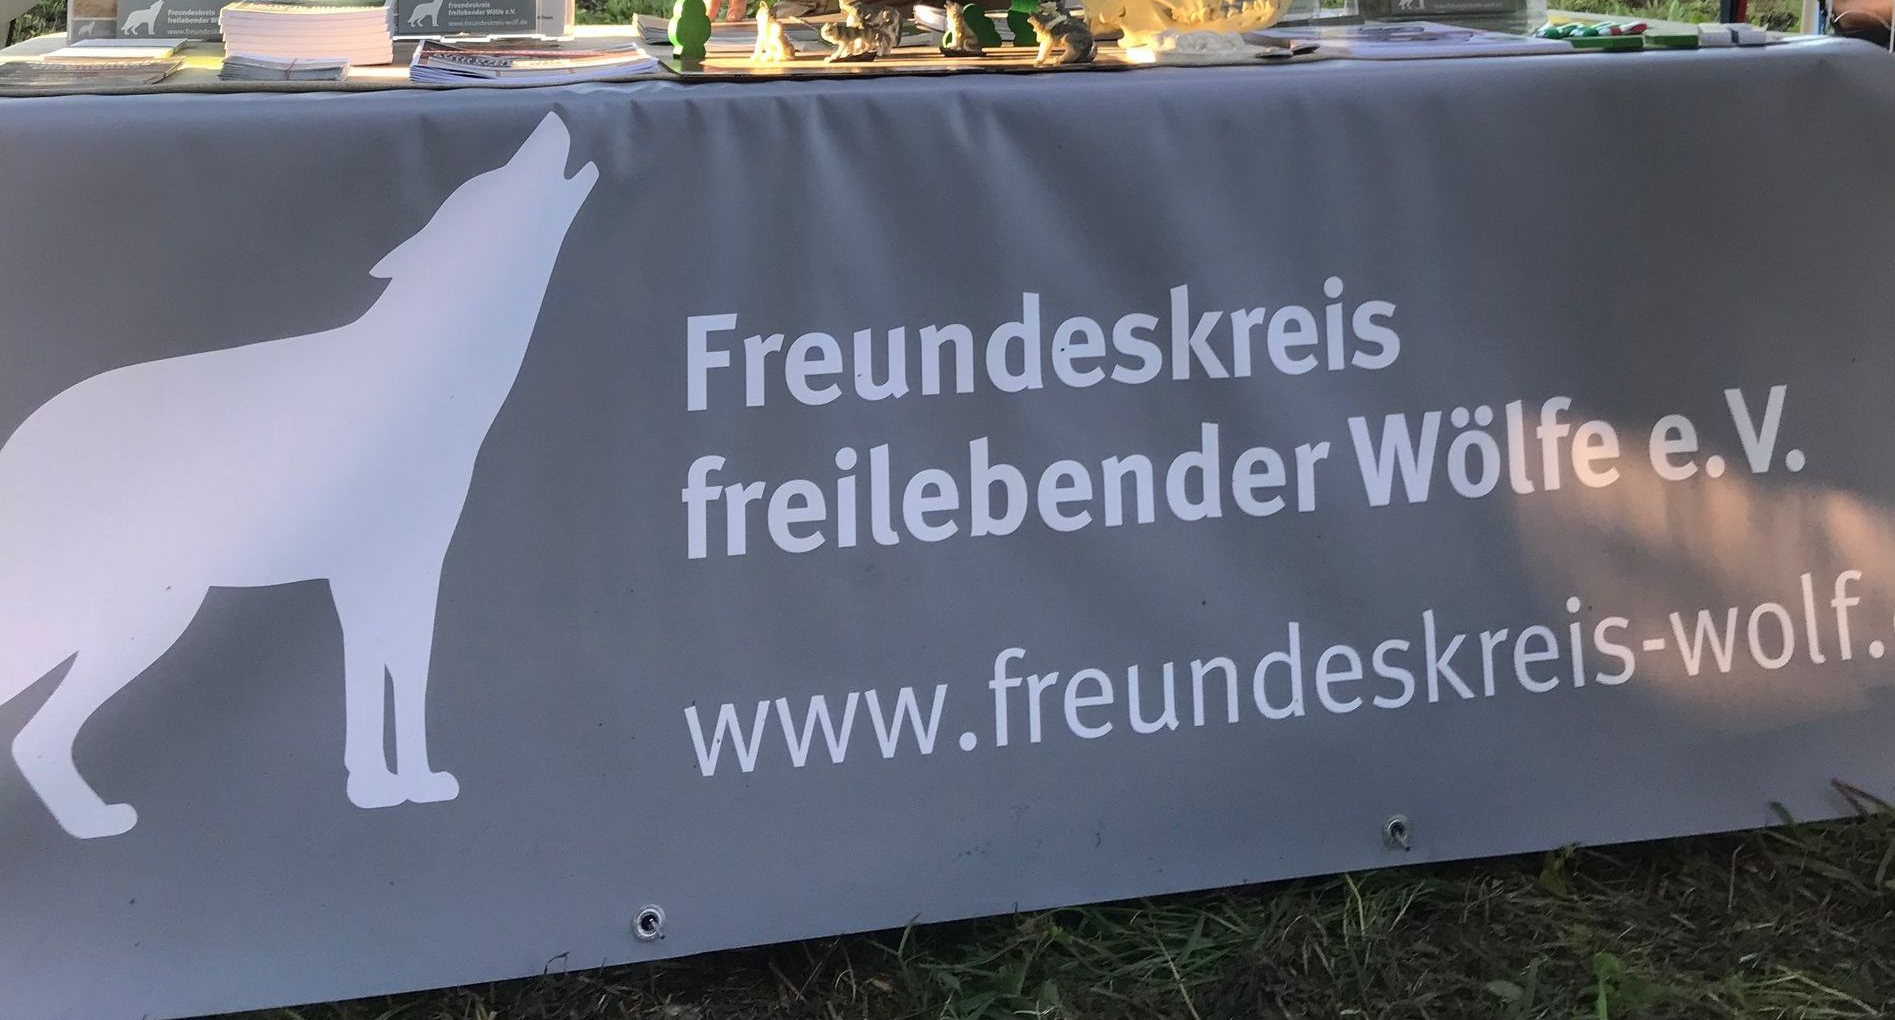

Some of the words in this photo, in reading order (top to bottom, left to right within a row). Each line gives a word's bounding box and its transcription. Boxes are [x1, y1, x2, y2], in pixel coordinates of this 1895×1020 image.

[167, 9, 216, 17] Freundeskreis
[448, 8, 485, 16] freilebender
[687, 276, 1400, 411] Freundeskreis
[681, 421, 1331, 559] freilebender
[1347, 396, 1621, 507] Wölfe
[1648, 384, 1806, 481] e.V.
[684, 569, 1895, 777] www.freundeskreis-wolf.
